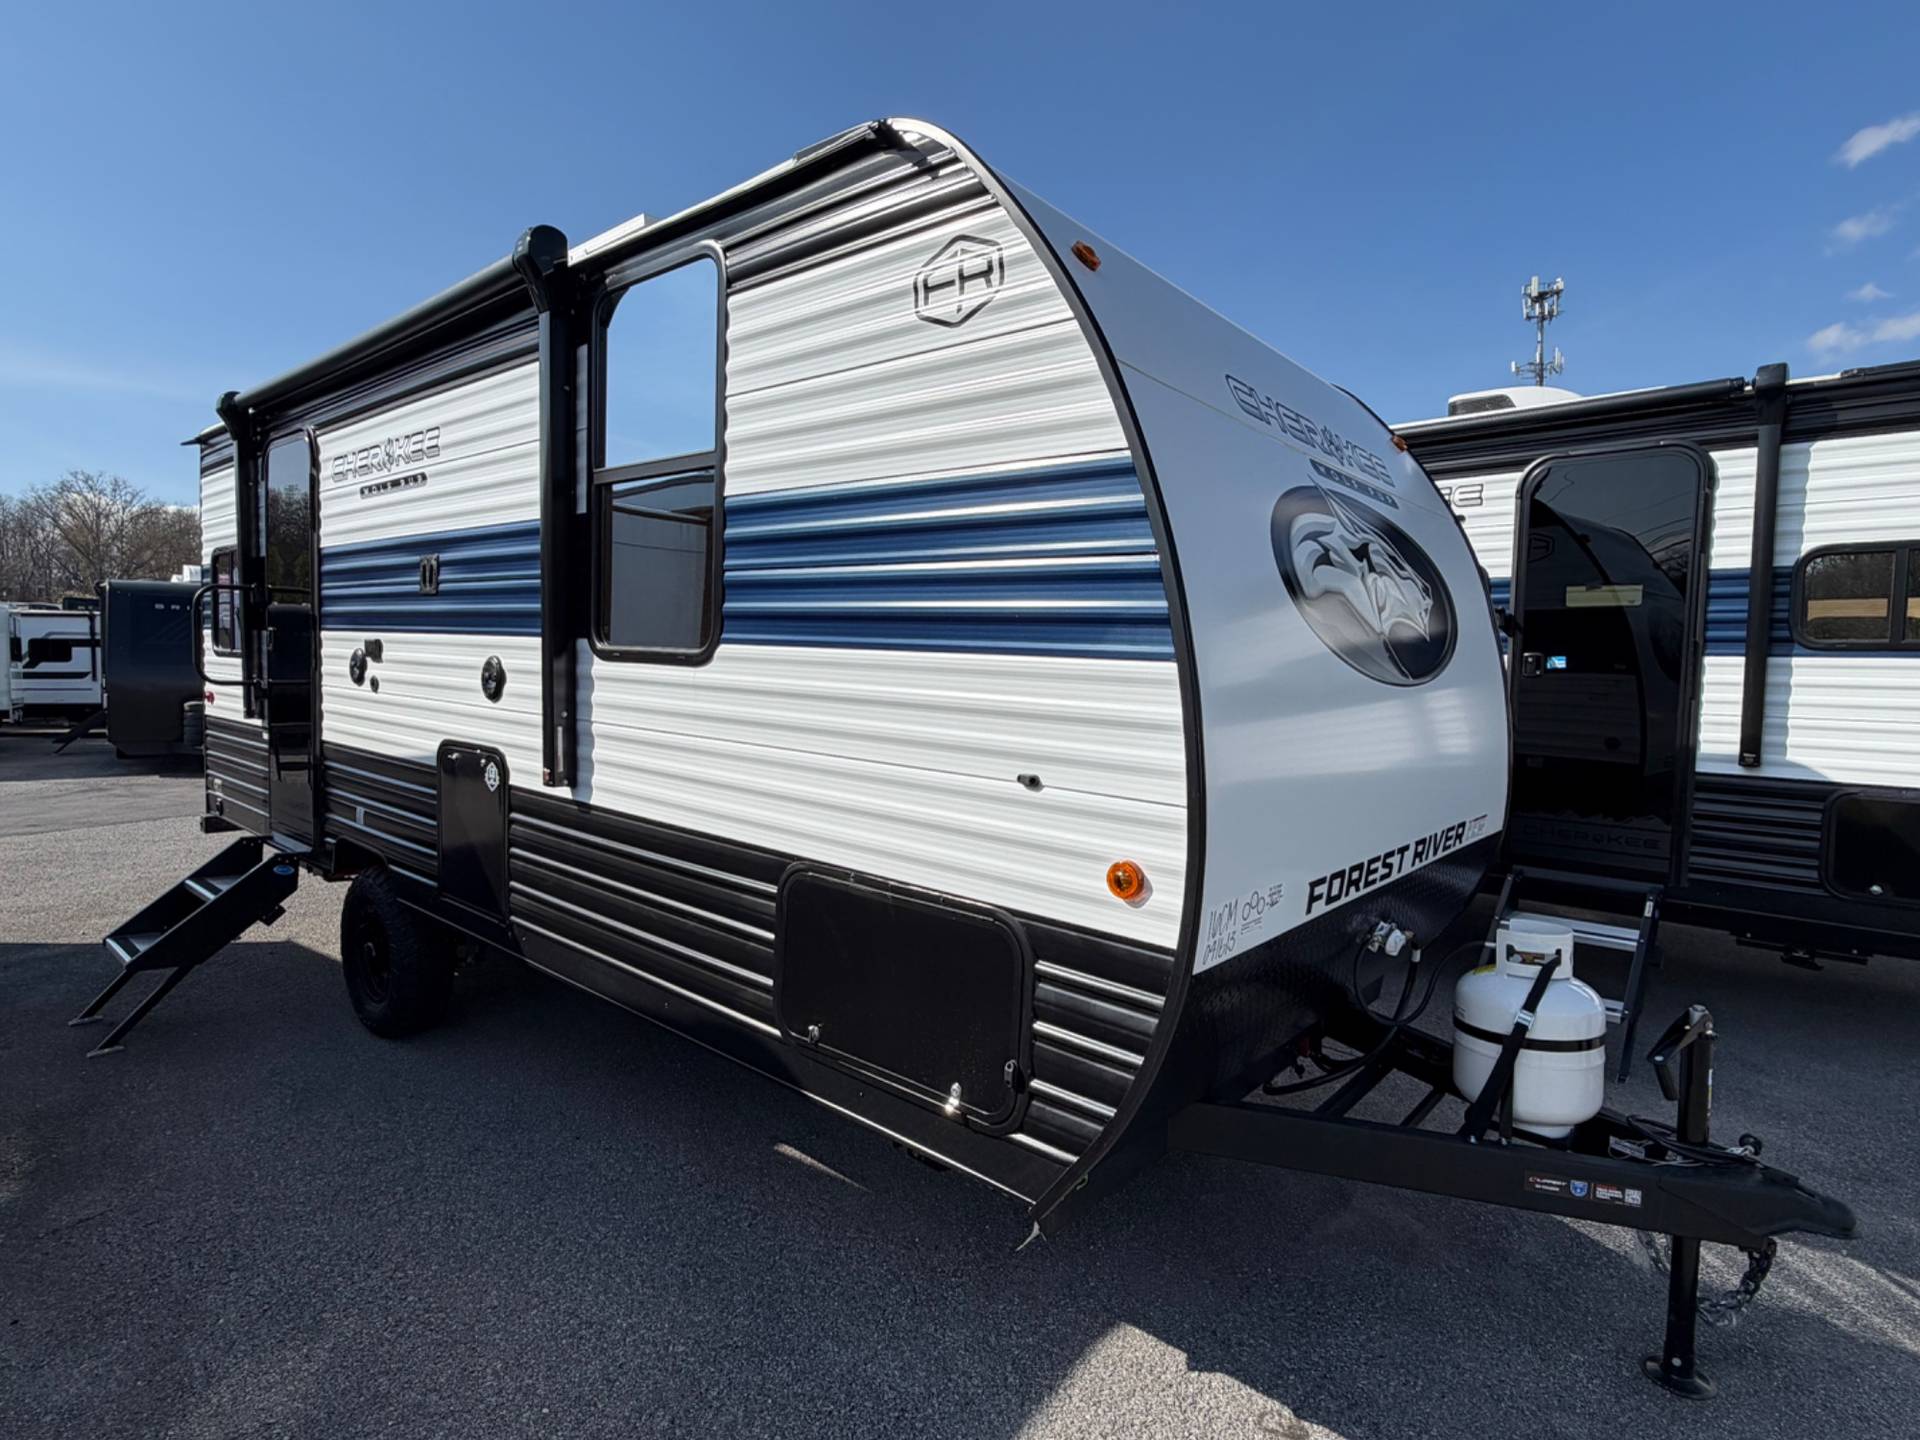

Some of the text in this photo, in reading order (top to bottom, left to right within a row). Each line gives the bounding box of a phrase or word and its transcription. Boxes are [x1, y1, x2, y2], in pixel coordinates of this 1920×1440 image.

[330, 426, 441, 483] CHEROKEE
[1224, 374, 1396, 488] CHEROKEE
[1304, 843, 1411, 916] FOREST
[1411, 820, 1467, 868] RIVER
